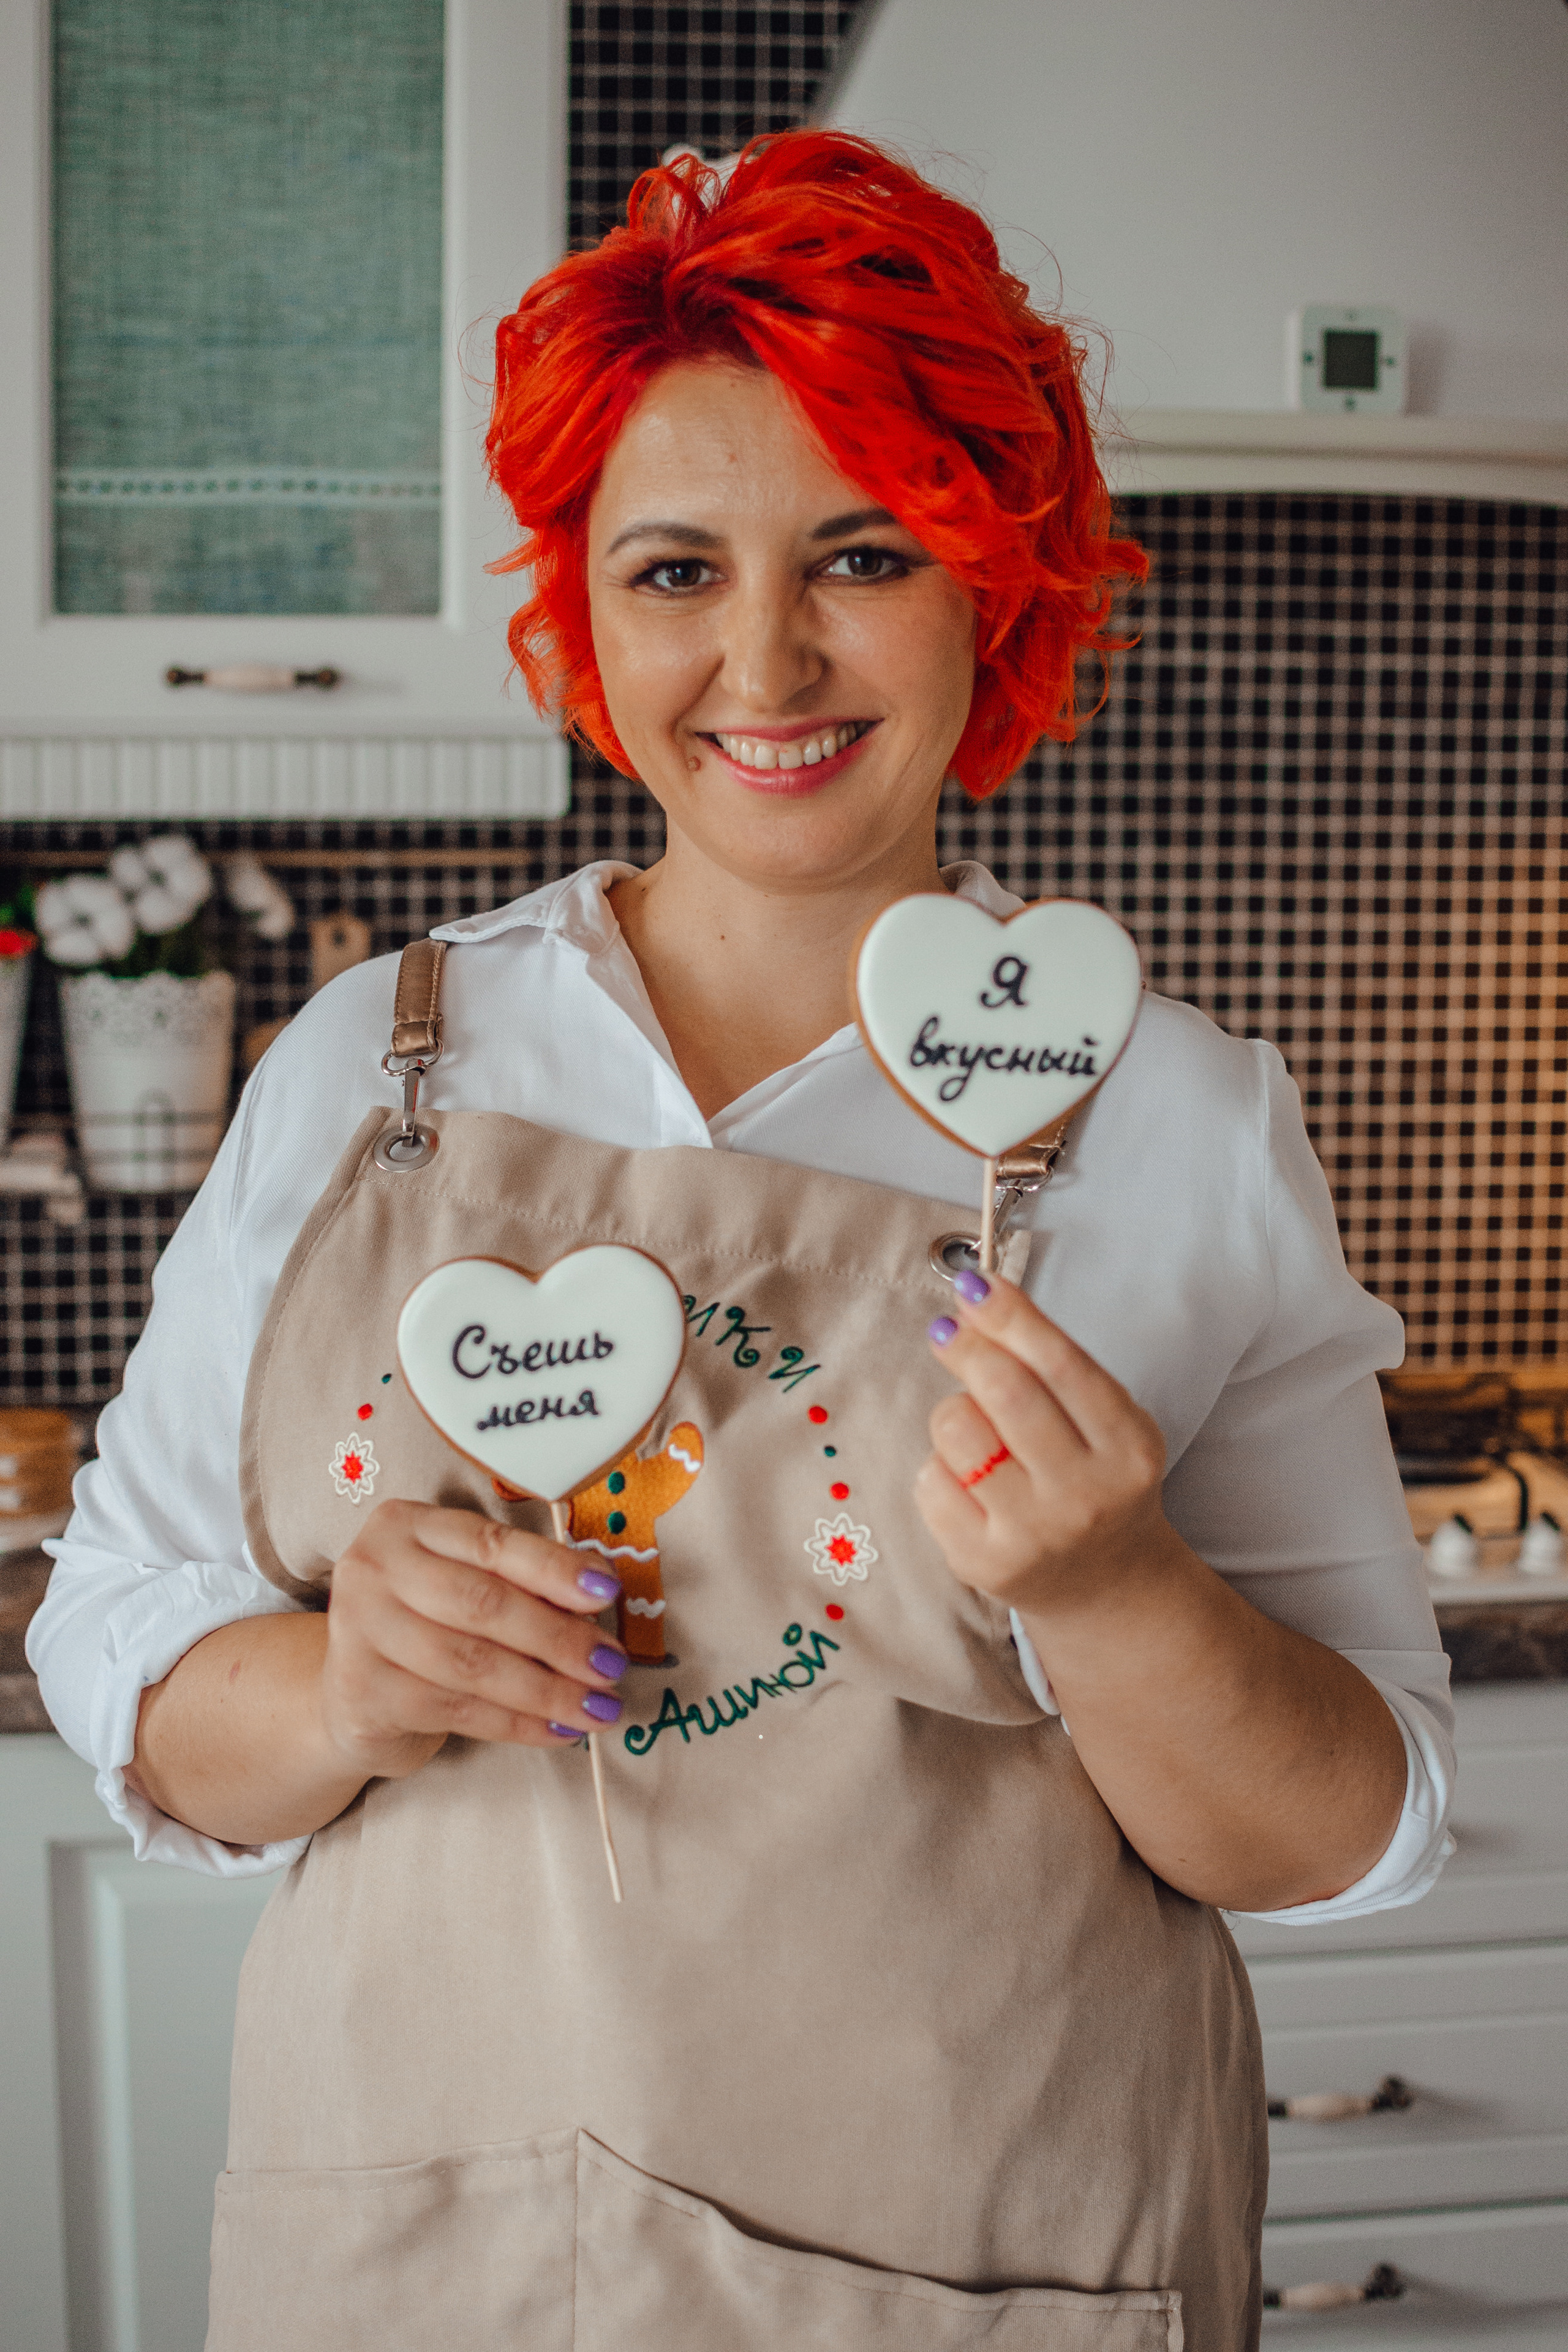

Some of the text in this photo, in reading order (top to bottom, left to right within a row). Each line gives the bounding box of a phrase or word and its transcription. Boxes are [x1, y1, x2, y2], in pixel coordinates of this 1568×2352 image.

[980, 956, 1028, 1009] Я
[909, 1016, 1099, 1102] вкусный
[451, 1323, 615, 1379] Съешь
[475, 1389, 601, 1431] меня
